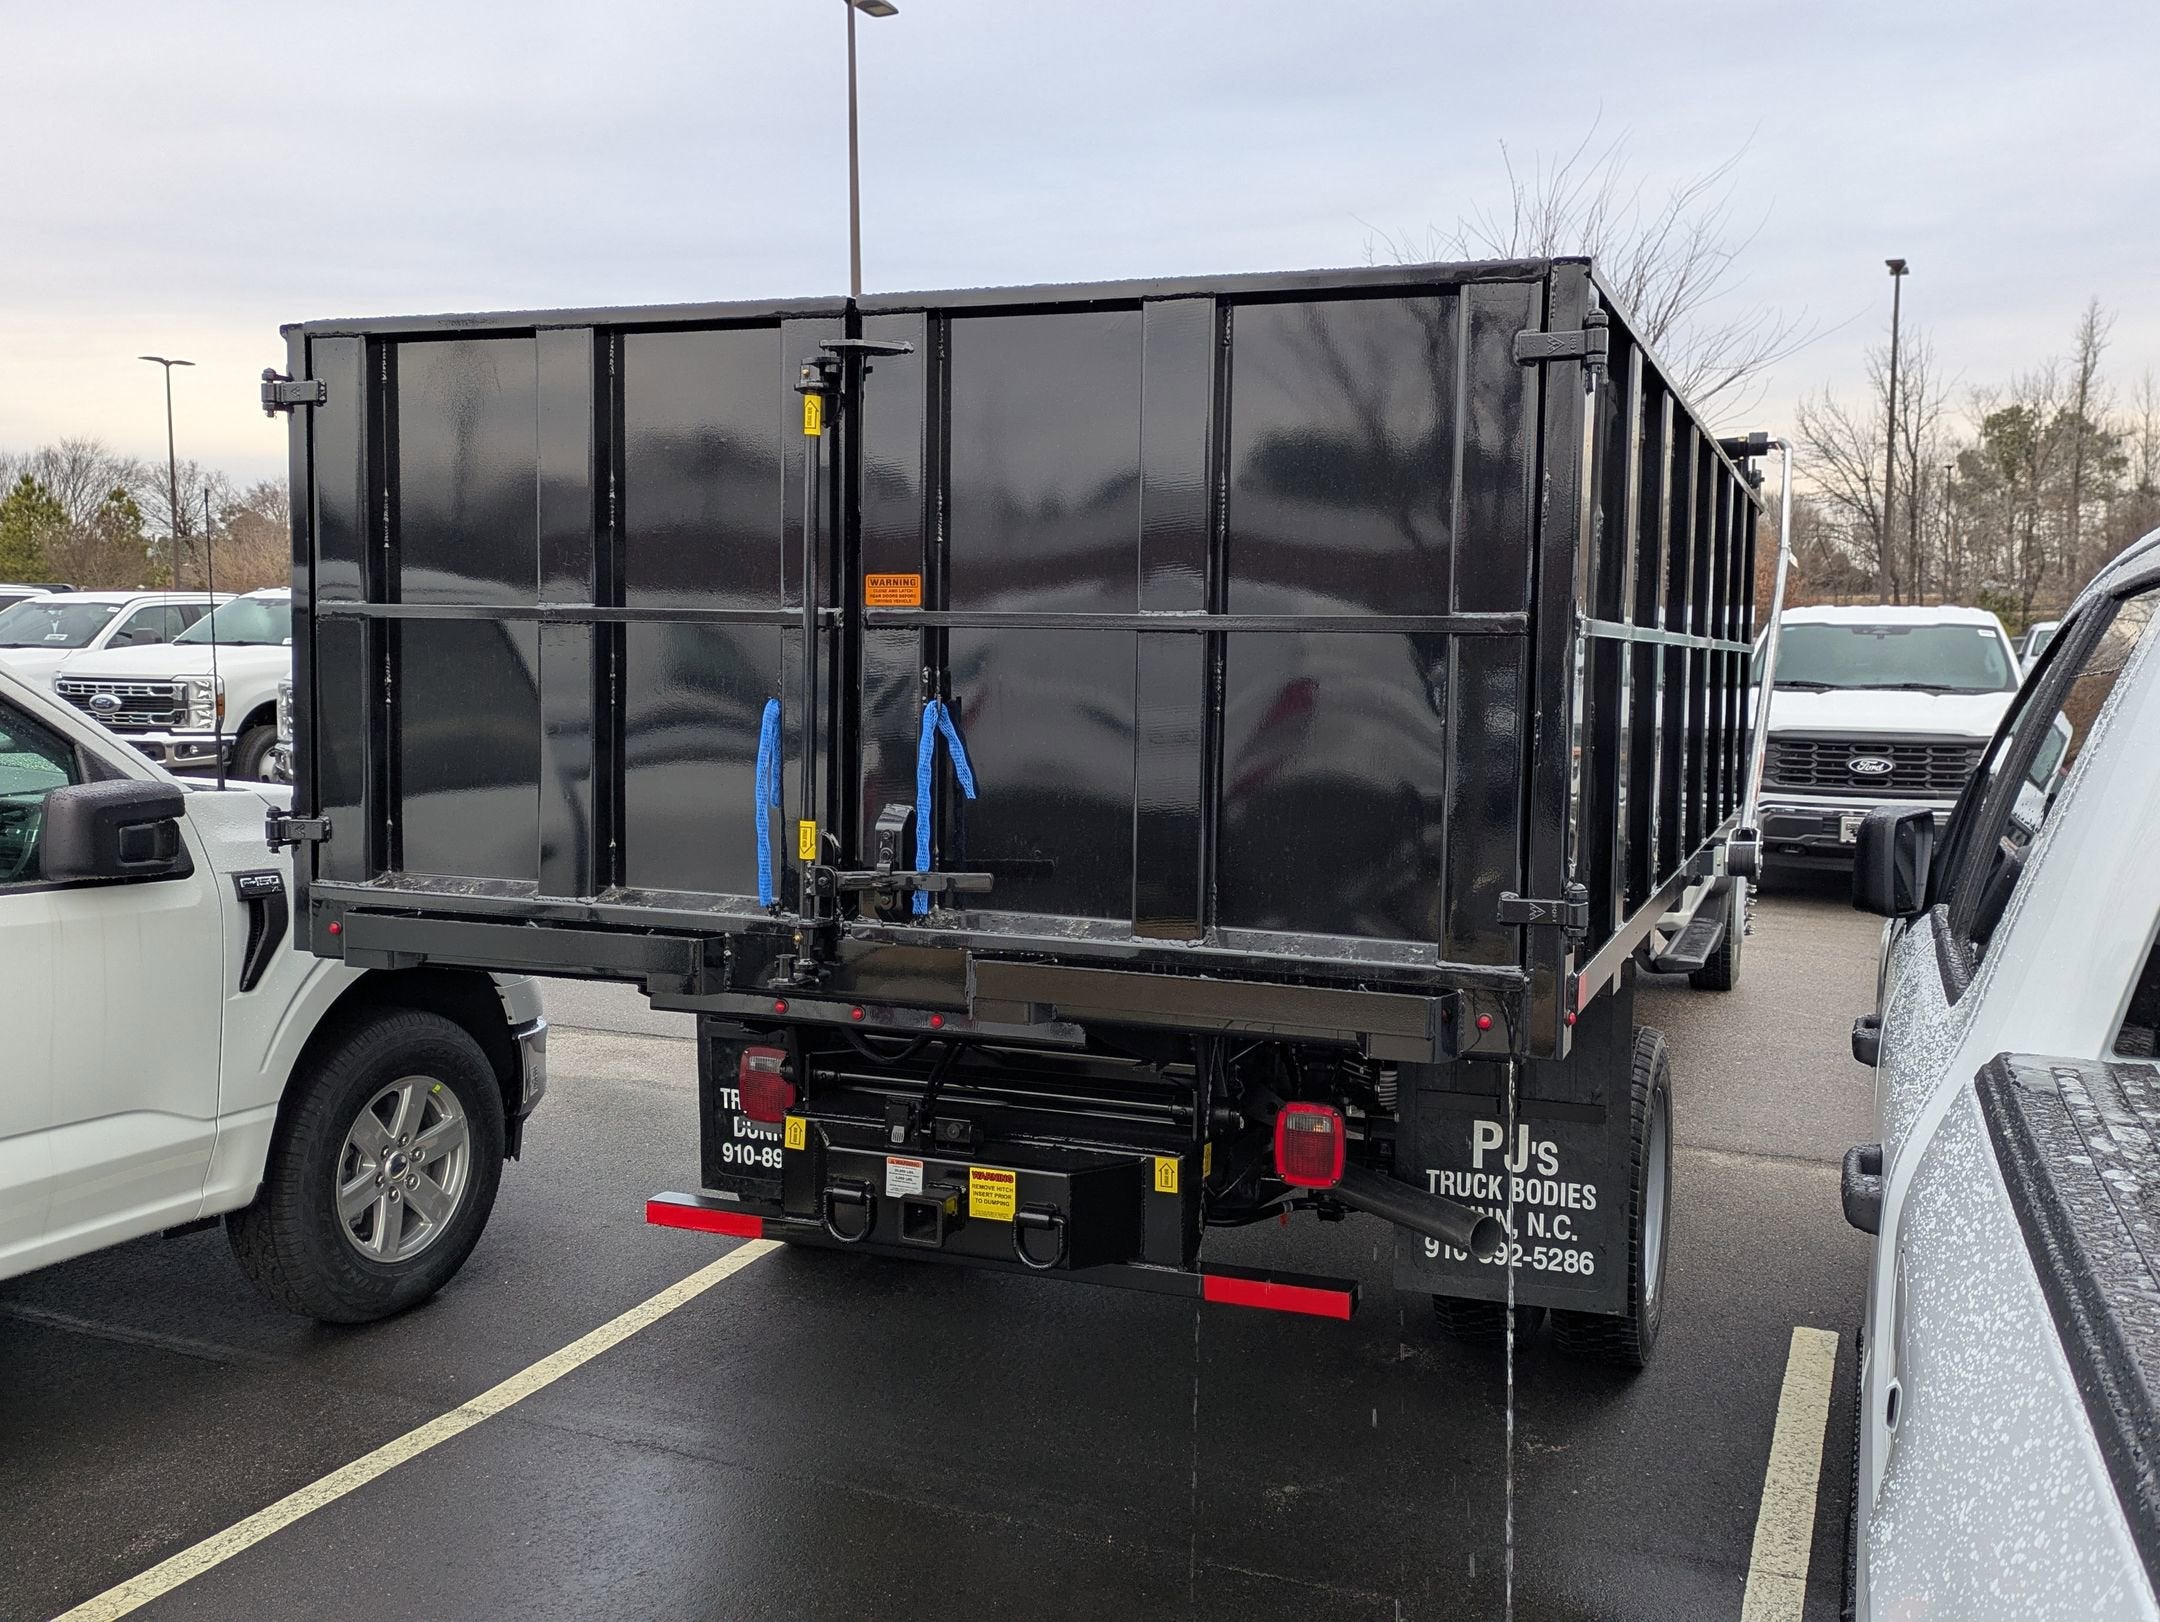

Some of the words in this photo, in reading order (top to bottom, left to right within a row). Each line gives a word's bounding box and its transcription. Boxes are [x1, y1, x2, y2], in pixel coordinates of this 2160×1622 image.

[870, 578, 916, 586] WARNING
[1856, 760, 1884, 771] Ford
[239, 875, 279, 888] F-150
[722, 1142, 783, 1169] 910-89
[971, 1170, 1014, 1184] WARNING
[972, 1183, 995, 1191] REMOVE
[1425, 1169, 1503, 1200] TRUCK
[1511, 1176, 1597, 1210] BODIES
[973, 1190, 993, 1198] INSERT
[984, 1199, 1010, 1207] DUMPING
[1527, 1212, 1578, 1242] N.C.
